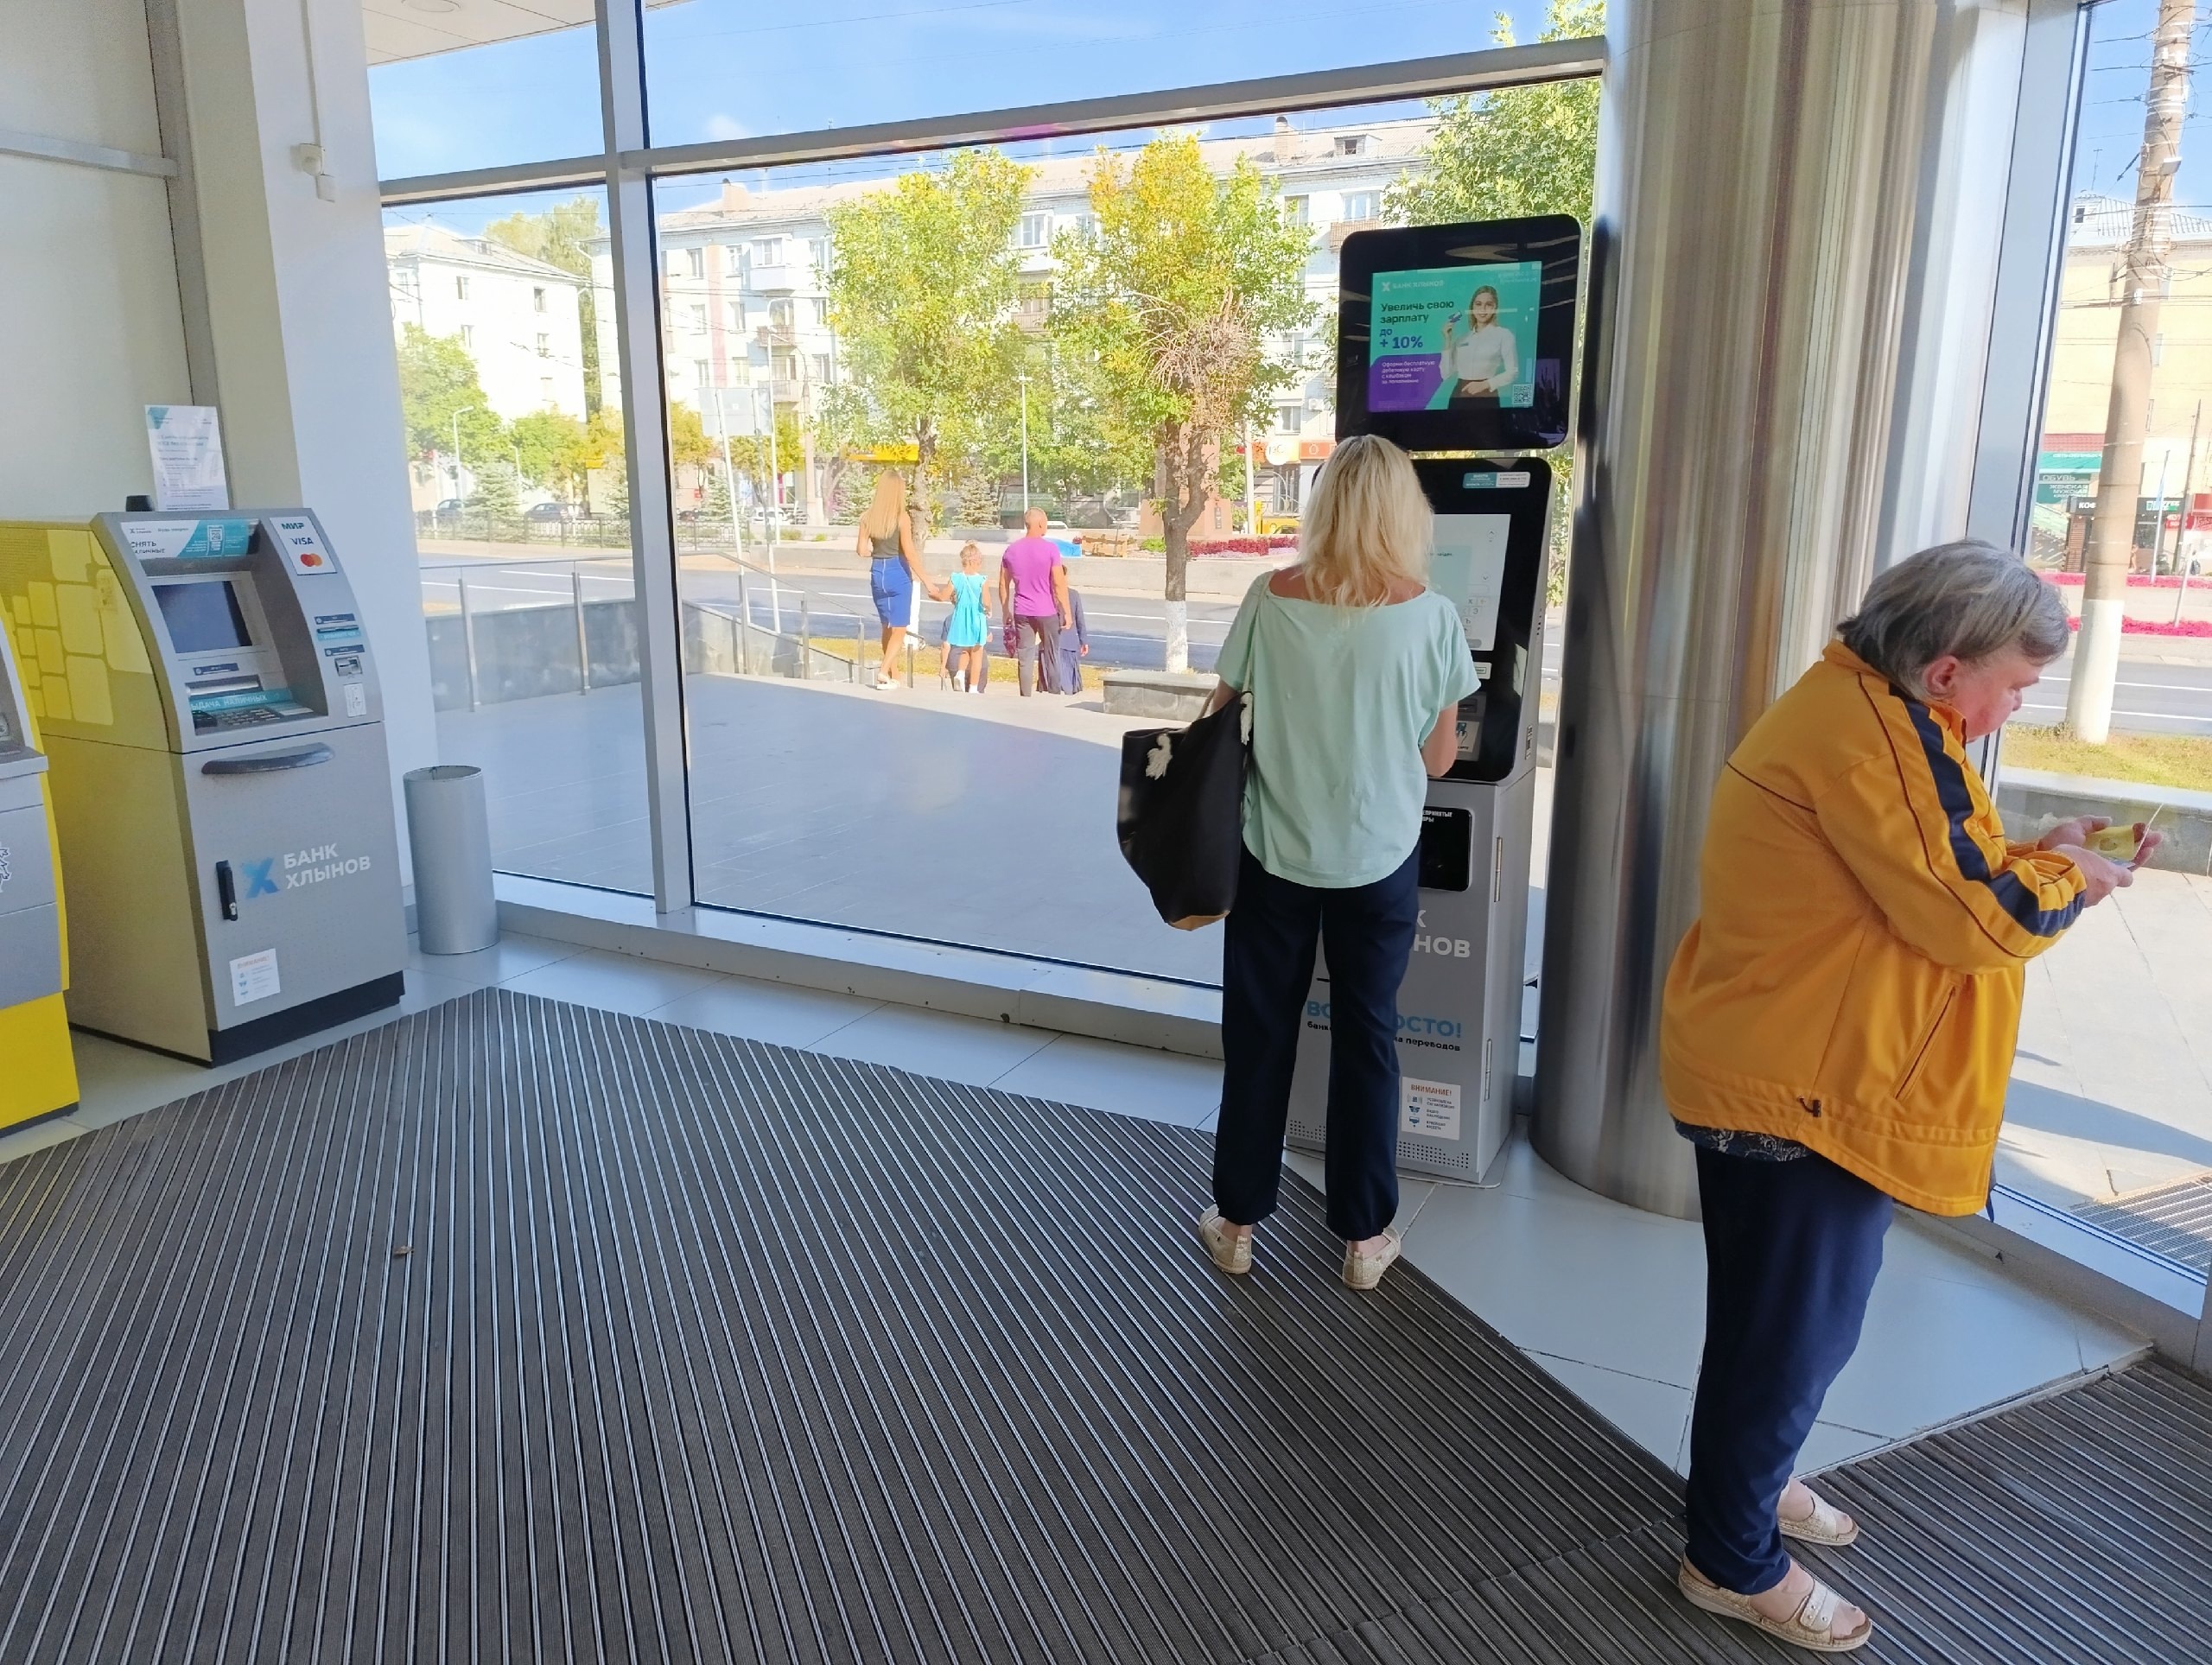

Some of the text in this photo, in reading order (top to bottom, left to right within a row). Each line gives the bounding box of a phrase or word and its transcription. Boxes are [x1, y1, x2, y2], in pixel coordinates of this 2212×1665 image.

[1381, 303, 1424, 312] Увеличь
[1380, 314, 1429, 325] зарплату
[1380, 328, 1392, 337] до
[1380, 336, 1423, 349] + 10%
[130, 540, 157, 549] СНЯТЬ
[289, 537, 315, 545] VISA
[191, 694, 268, 710] ЫДАЧА НАЛИЧНЫХ
[283, 842, 339, 869] БАНК
[285, 855, 372, 890] ХЛЫНОВ
[1414, 933, 1471, 958] НОВ
[1406, 1038, 1460, 1052] переводов
[1410, 1084, 1452, 1096] ВНИМАНИЕ!
